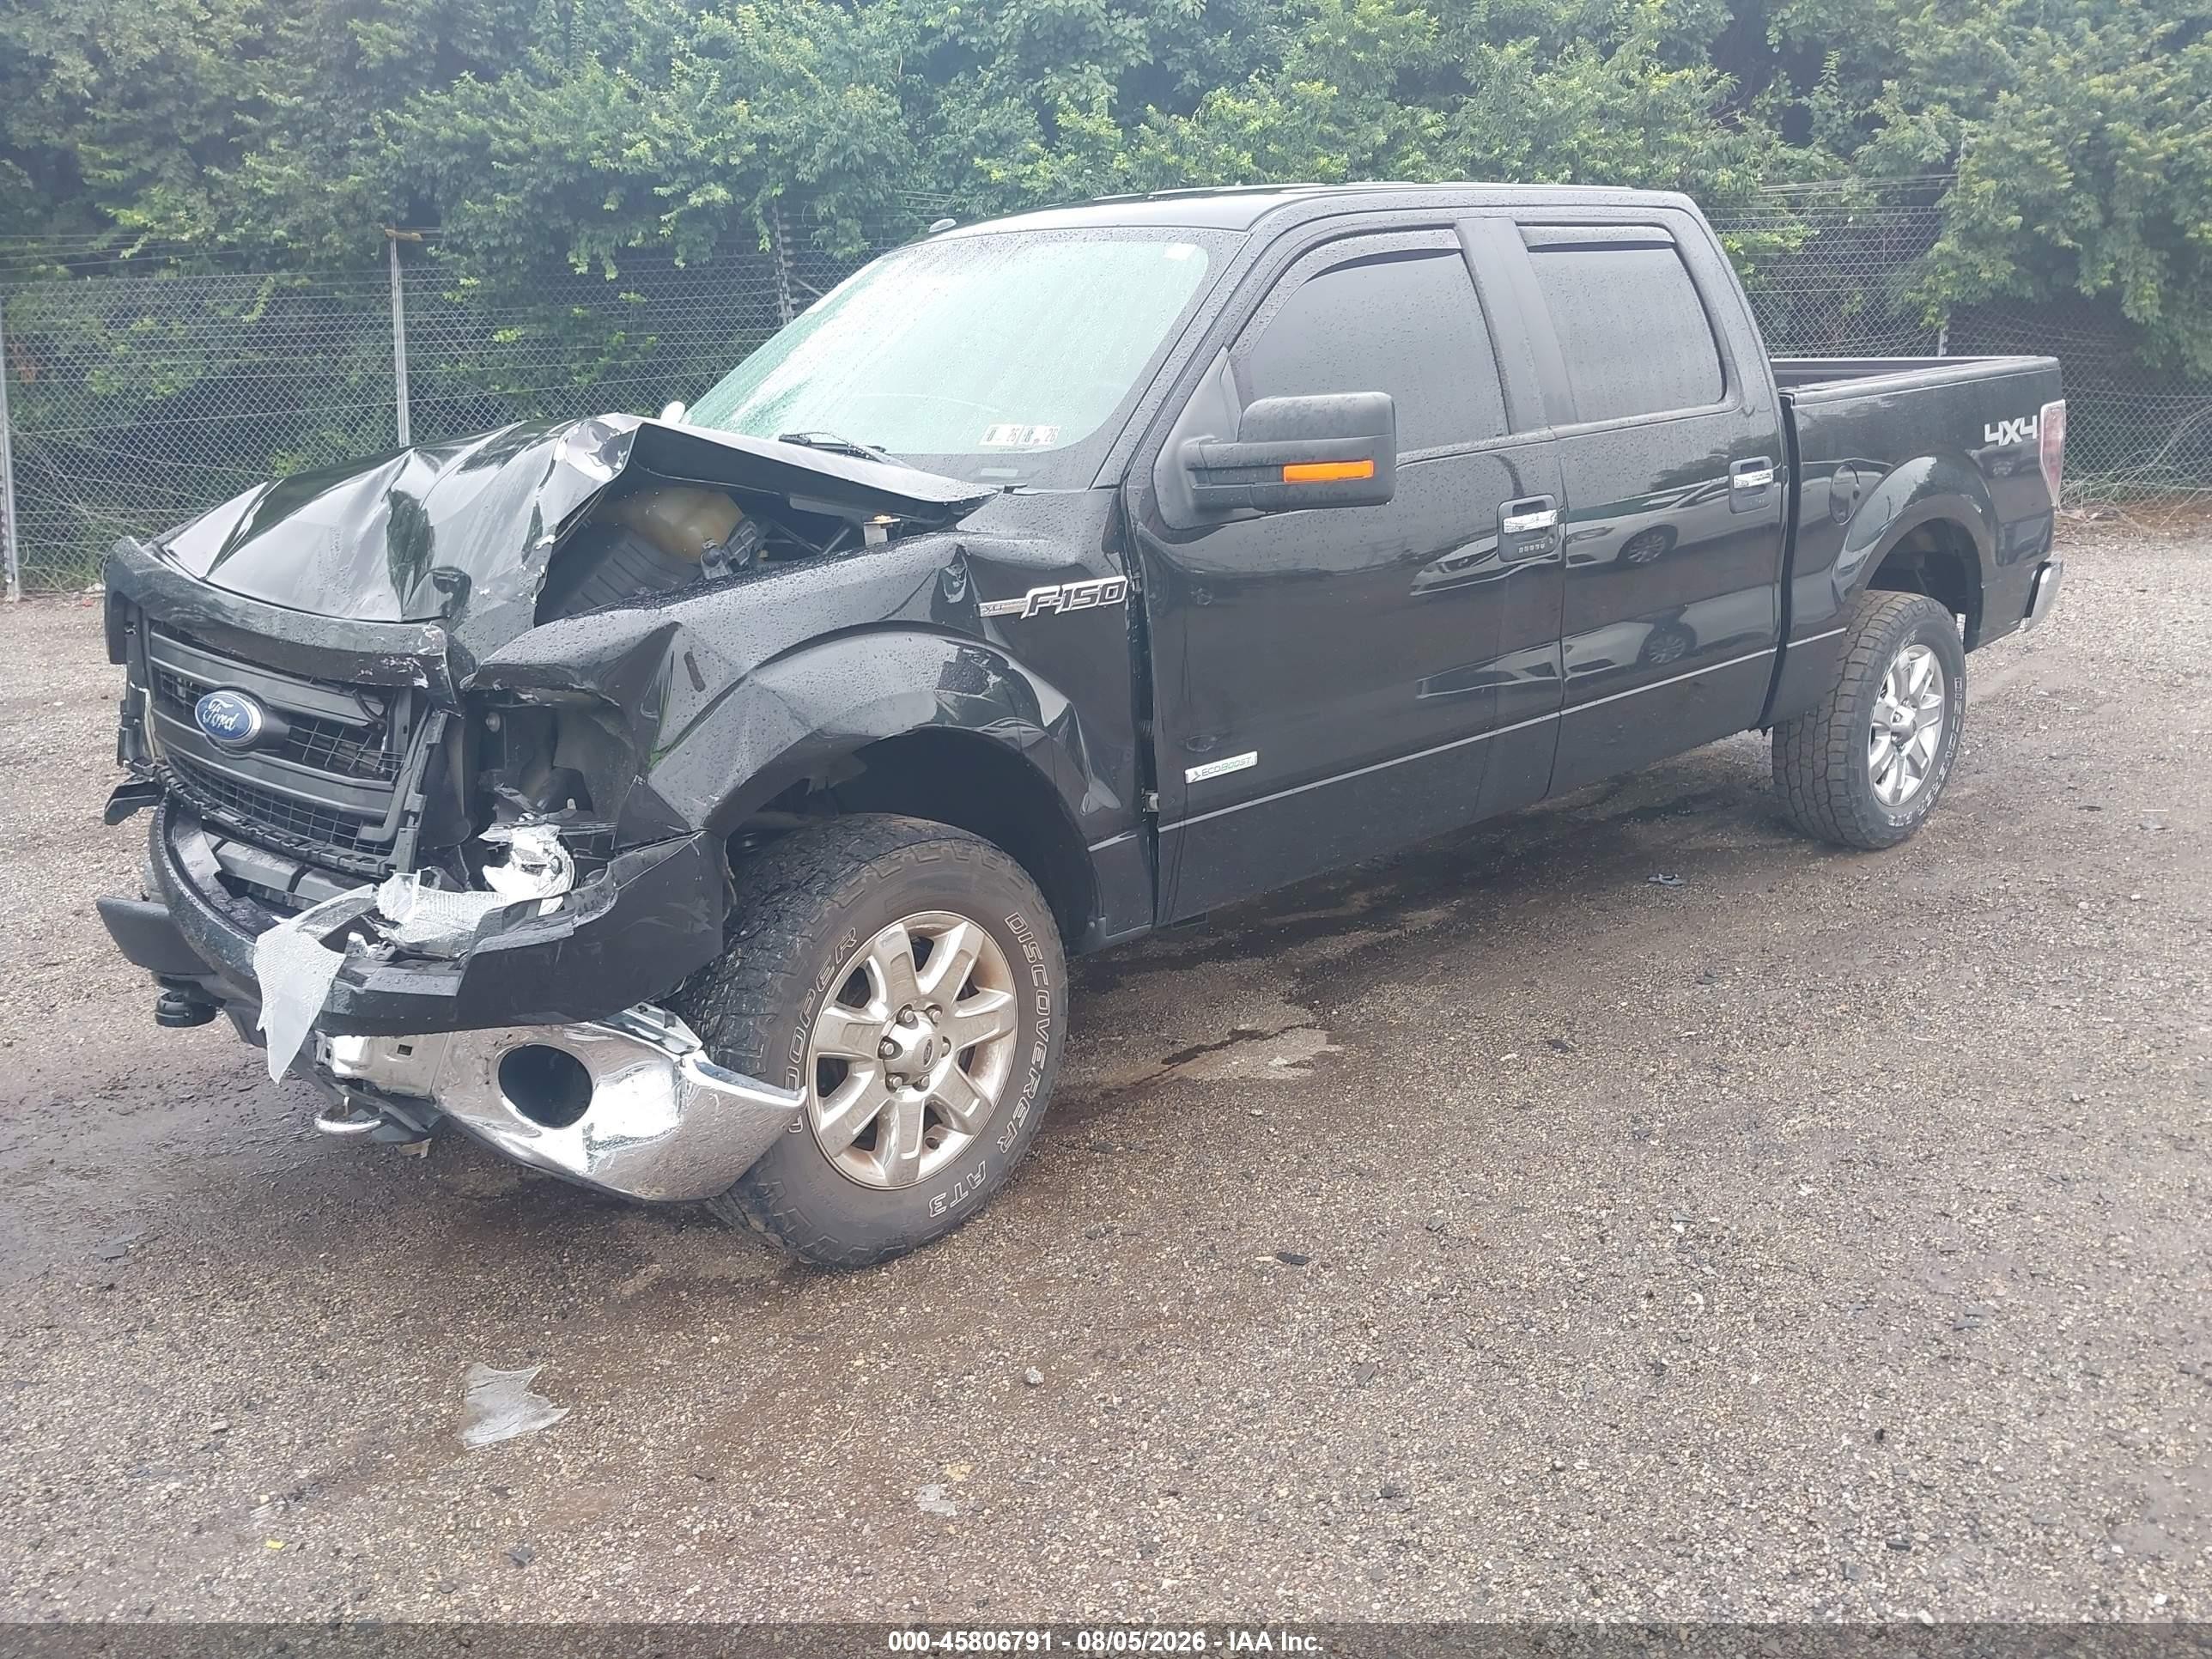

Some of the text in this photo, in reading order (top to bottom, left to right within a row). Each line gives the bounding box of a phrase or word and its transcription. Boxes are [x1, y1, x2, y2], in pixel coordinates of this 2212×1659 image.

[1984, 415, 2038, 447] 4X4
[1022, 576, 1127, 619] F-150
[203, 698, 240, 731] Ford
[1201, 756, 1252, 777] ECOBOOST
[929, 912, 1050, 1218] DISCOVERER AT3
